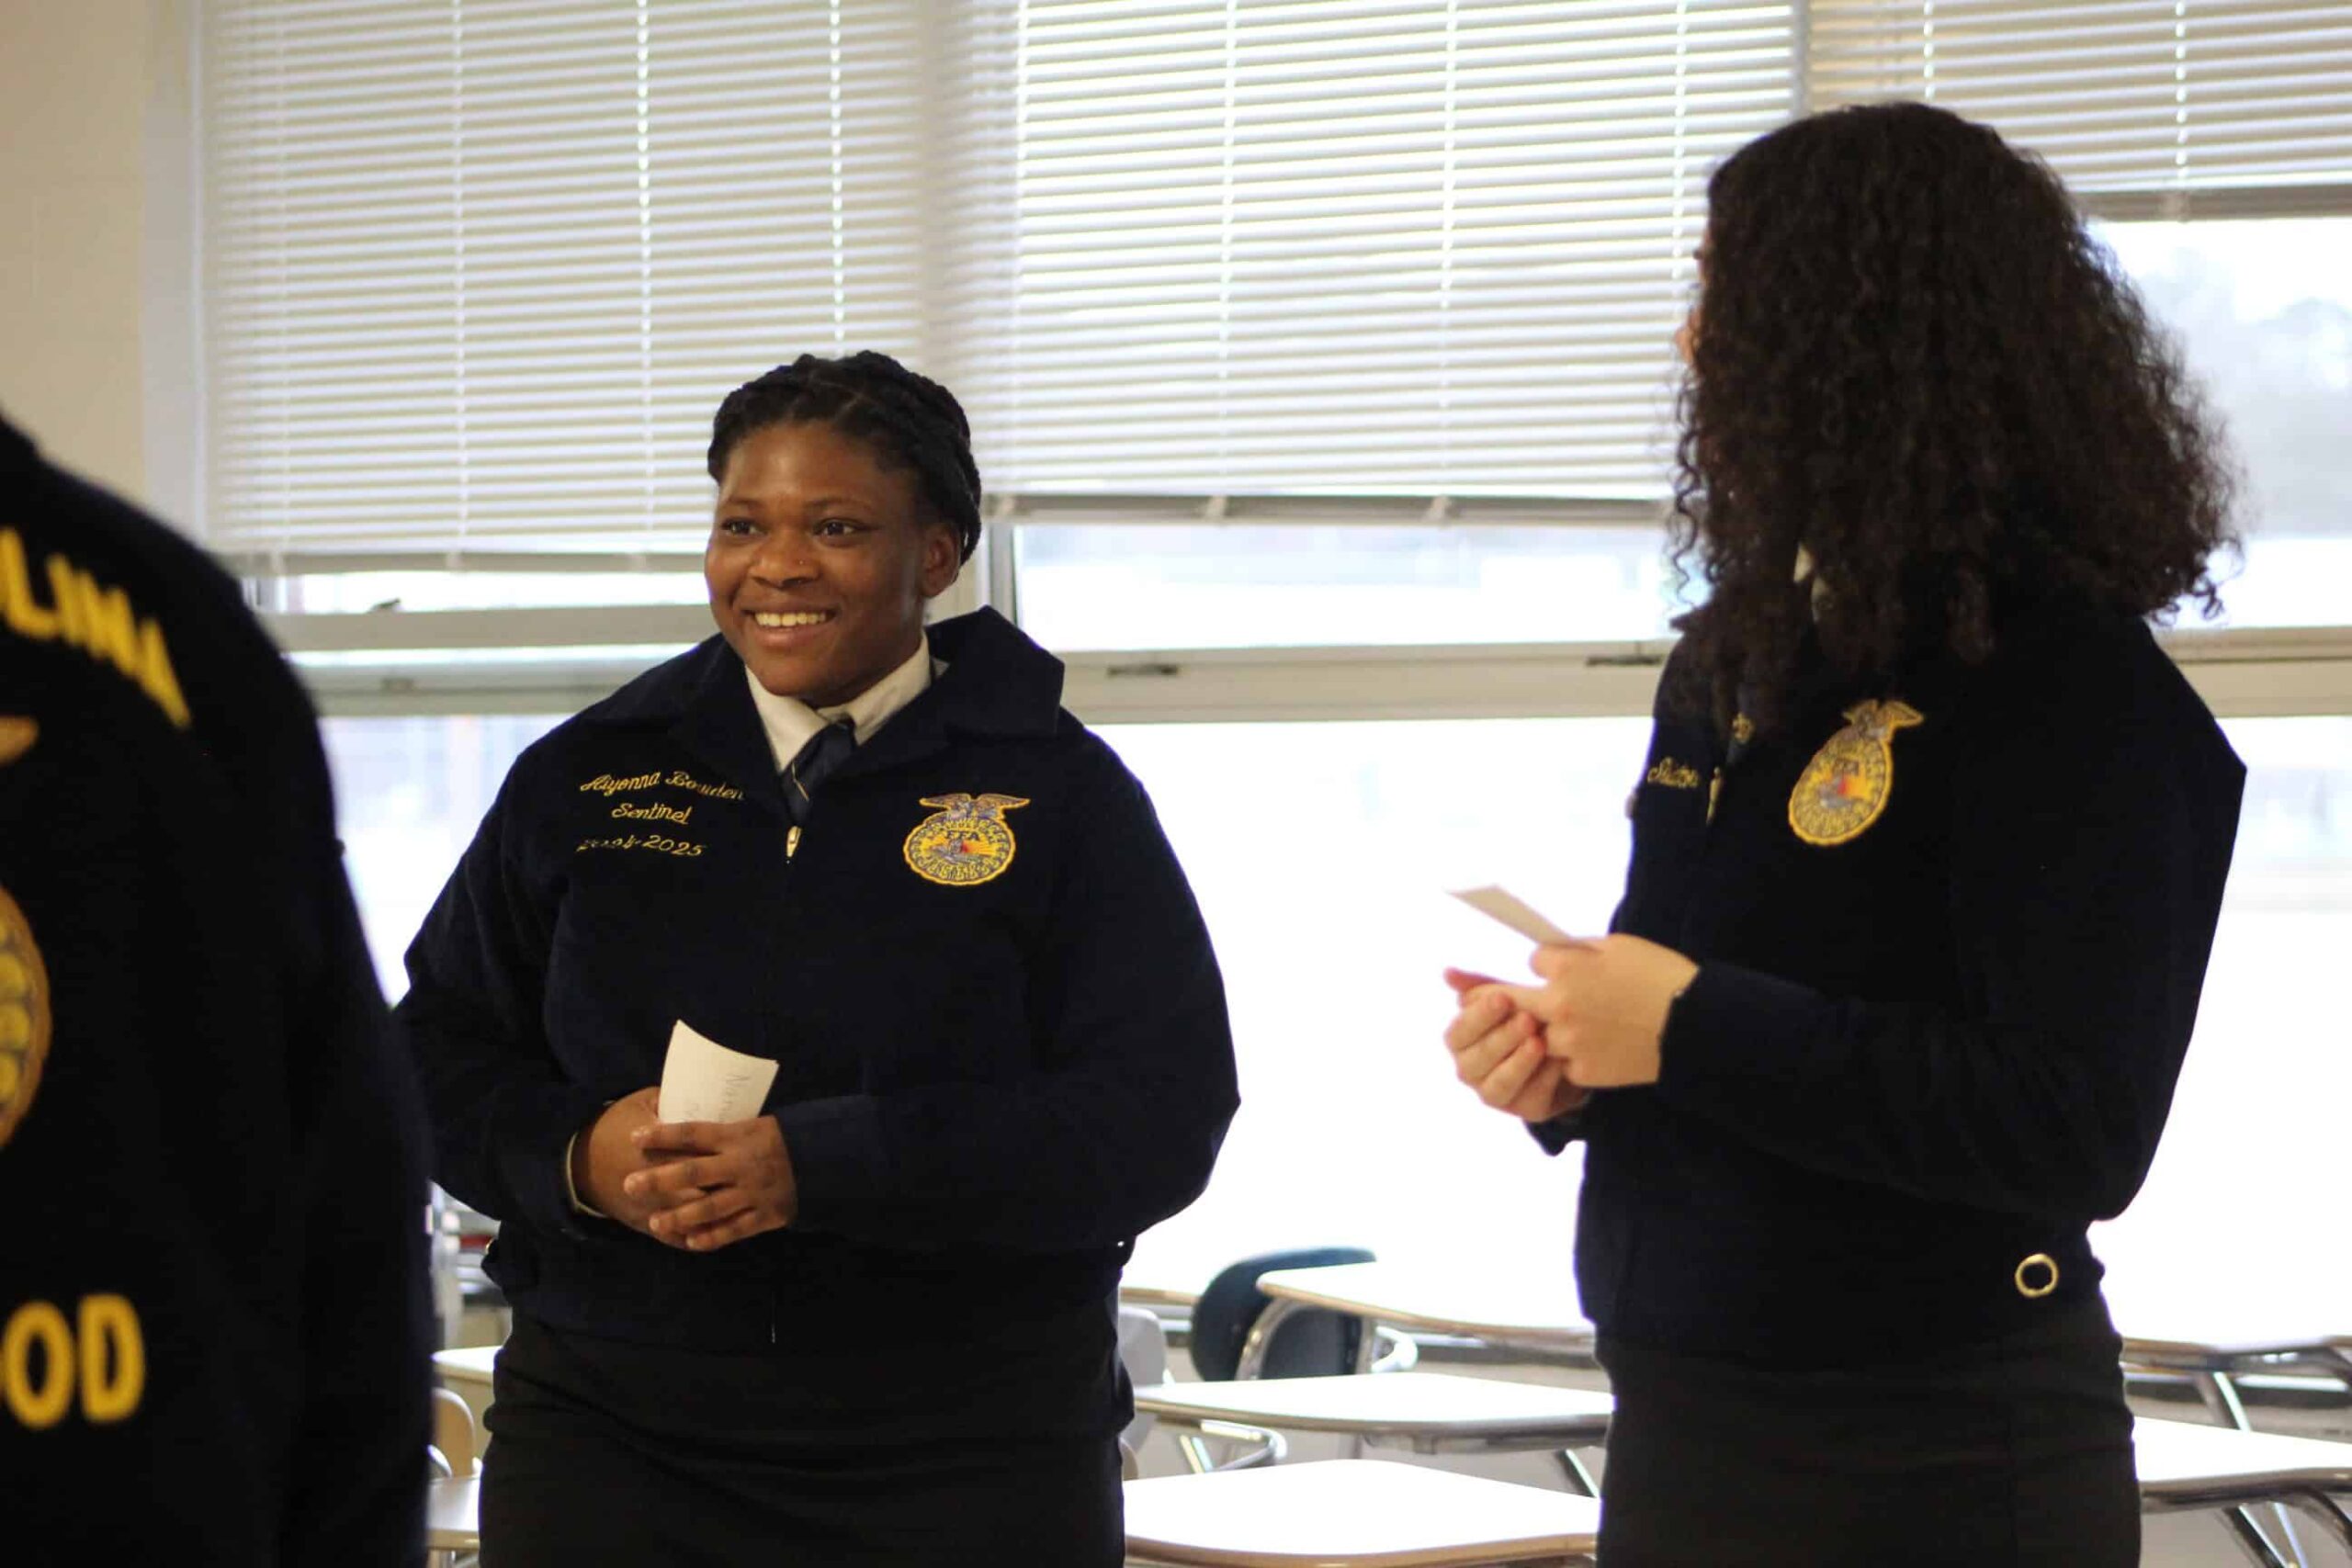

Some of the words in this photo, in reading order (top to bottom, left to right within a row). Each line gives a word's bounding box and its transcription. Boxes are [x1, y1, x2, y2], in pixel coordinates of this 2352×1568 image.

[0, 526, 190, 728] LINA
[610, 801, 693, 826] Sentinel
[947, 830, 980, 840] FFA
[0, 1294, 146, 1429] OD
